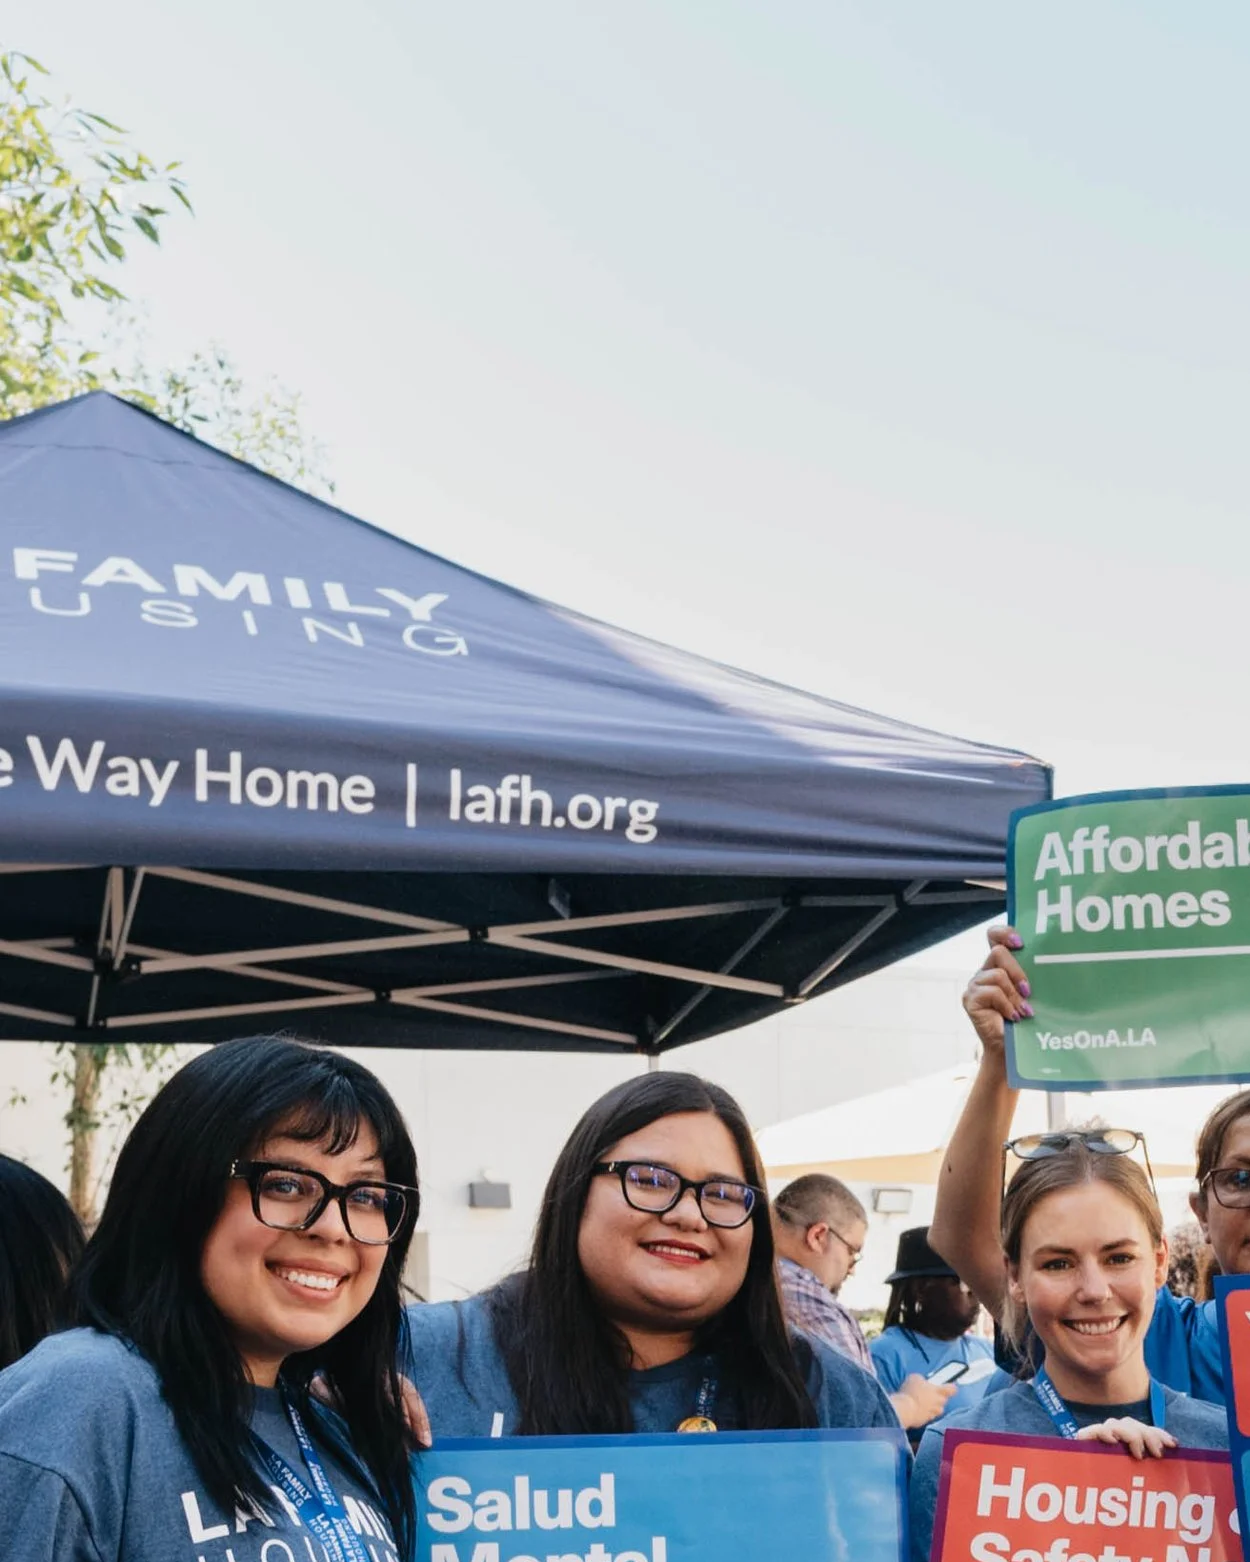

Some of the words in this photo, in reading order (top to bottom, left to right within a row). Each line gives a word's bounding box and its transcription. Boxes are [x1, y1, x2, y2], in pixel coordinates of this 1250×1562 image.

[13, 547, 449, 622] FAMILY
[27, 736, 180, 807] Way
[195, 748, 376, 814] Home
[449, 768, 660, 844] lafh.org
[1034, 886, 1232, 934] Homes
[1036, 1027, 1157, 1050] YesOnA.LA
[280, 1466, 313, 1501] FAMILY
[426, 1473, 616, 1533] Salud
[976, 1464, 1216, 1545] Housing
